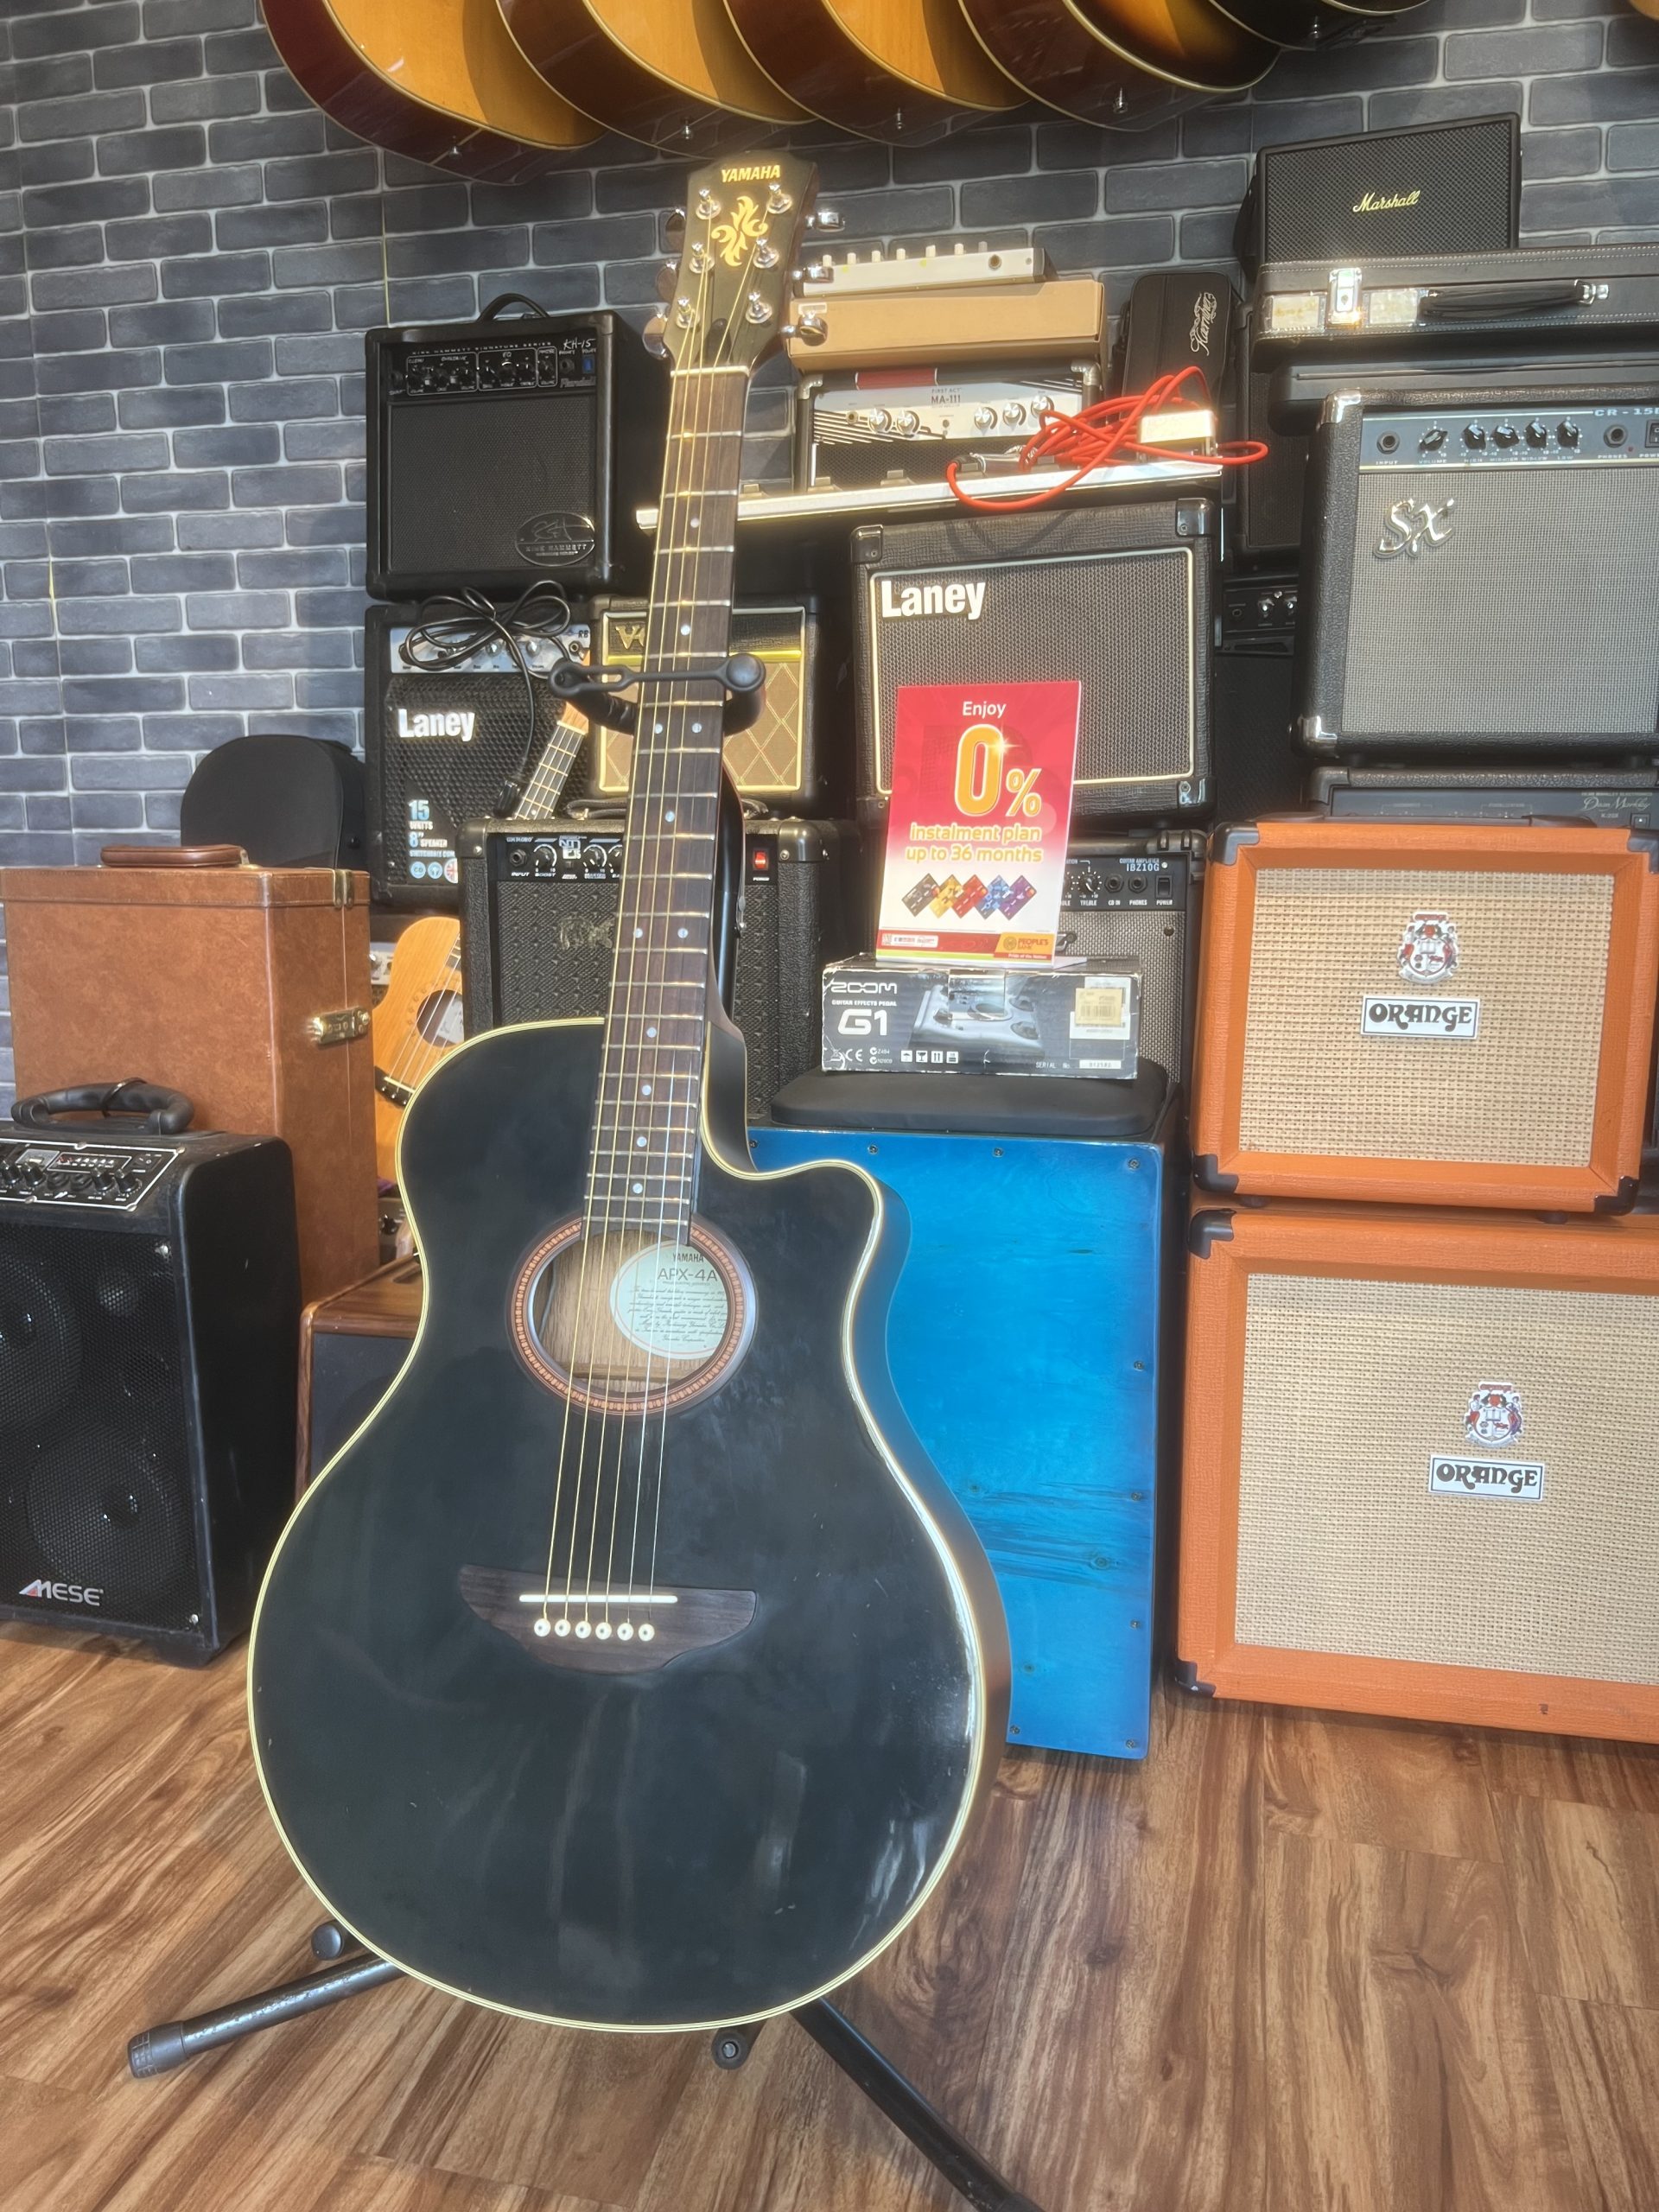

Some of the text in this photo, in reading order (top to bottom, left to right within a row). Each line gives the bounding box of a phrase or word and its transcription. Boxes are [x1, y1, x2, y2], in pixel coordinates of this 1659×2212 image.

[721, 164, 780, 182] YAMAHA
[1352, 189, 1421, 213] Marshall
[563, 337, 596, 351] KH-15
[931, 394, 961, 404] MA-111
[880, 580, 986, 620] Laney
[962, 701, 1007, 719] Enjoy
[397, 708, 474, 742] Laney
[955, 724, 1042, 817] 0%
[408, 799, 430, 821] 15
[910, 822, 1042, 845] instalment plan
[906, 844, 1043, 863] up to 36 months
[1126, 863, 1160, 872] IBZ10G
[831, 982, 898, 994] ZOOM
[837, 1008, 887, 1036] G1
[1369, 1003, 1472, 1033] ORANGE
[673, 1253, 704, 1262] YAMAHA
[658, 1268, 718, 1281] APX-4A
[1436, 1463, 1538, 1494] ORANGE
